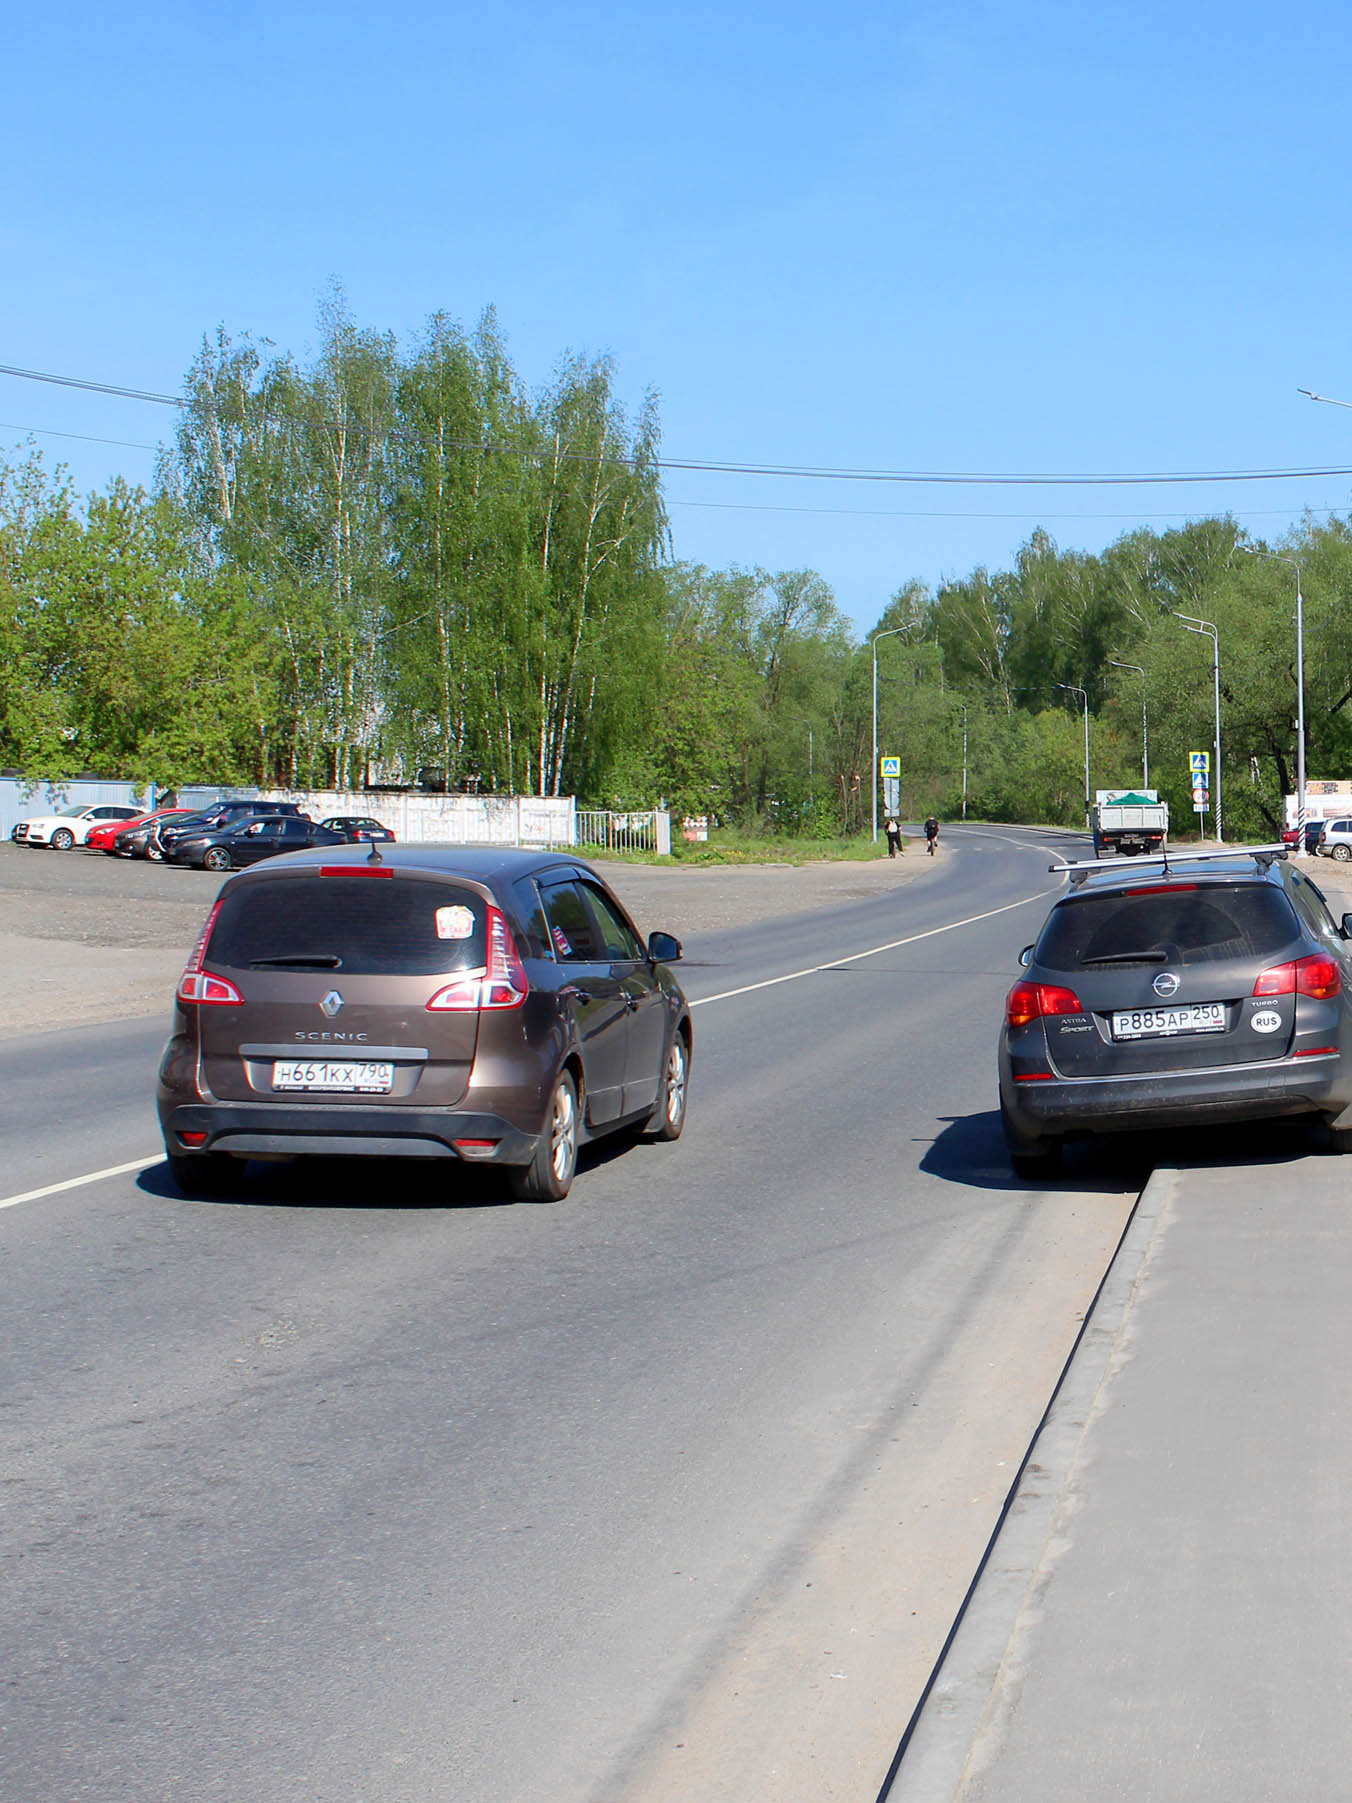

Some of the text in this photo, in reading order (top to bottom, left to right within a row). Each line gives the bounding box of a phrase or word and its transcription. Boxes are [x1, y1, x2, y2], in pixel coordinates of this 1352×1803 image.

[1251, 999, 1279, 1007] TURBO
[1193, 1004, 1220, 1020] 250
[1060, 1017, 1087, 1025] ASTRA
[1256, 1016, 1277, 1026] RUS
[295, 1031, 369, 1041] SCENIC
[359, 1063, 388, 1079] 790
